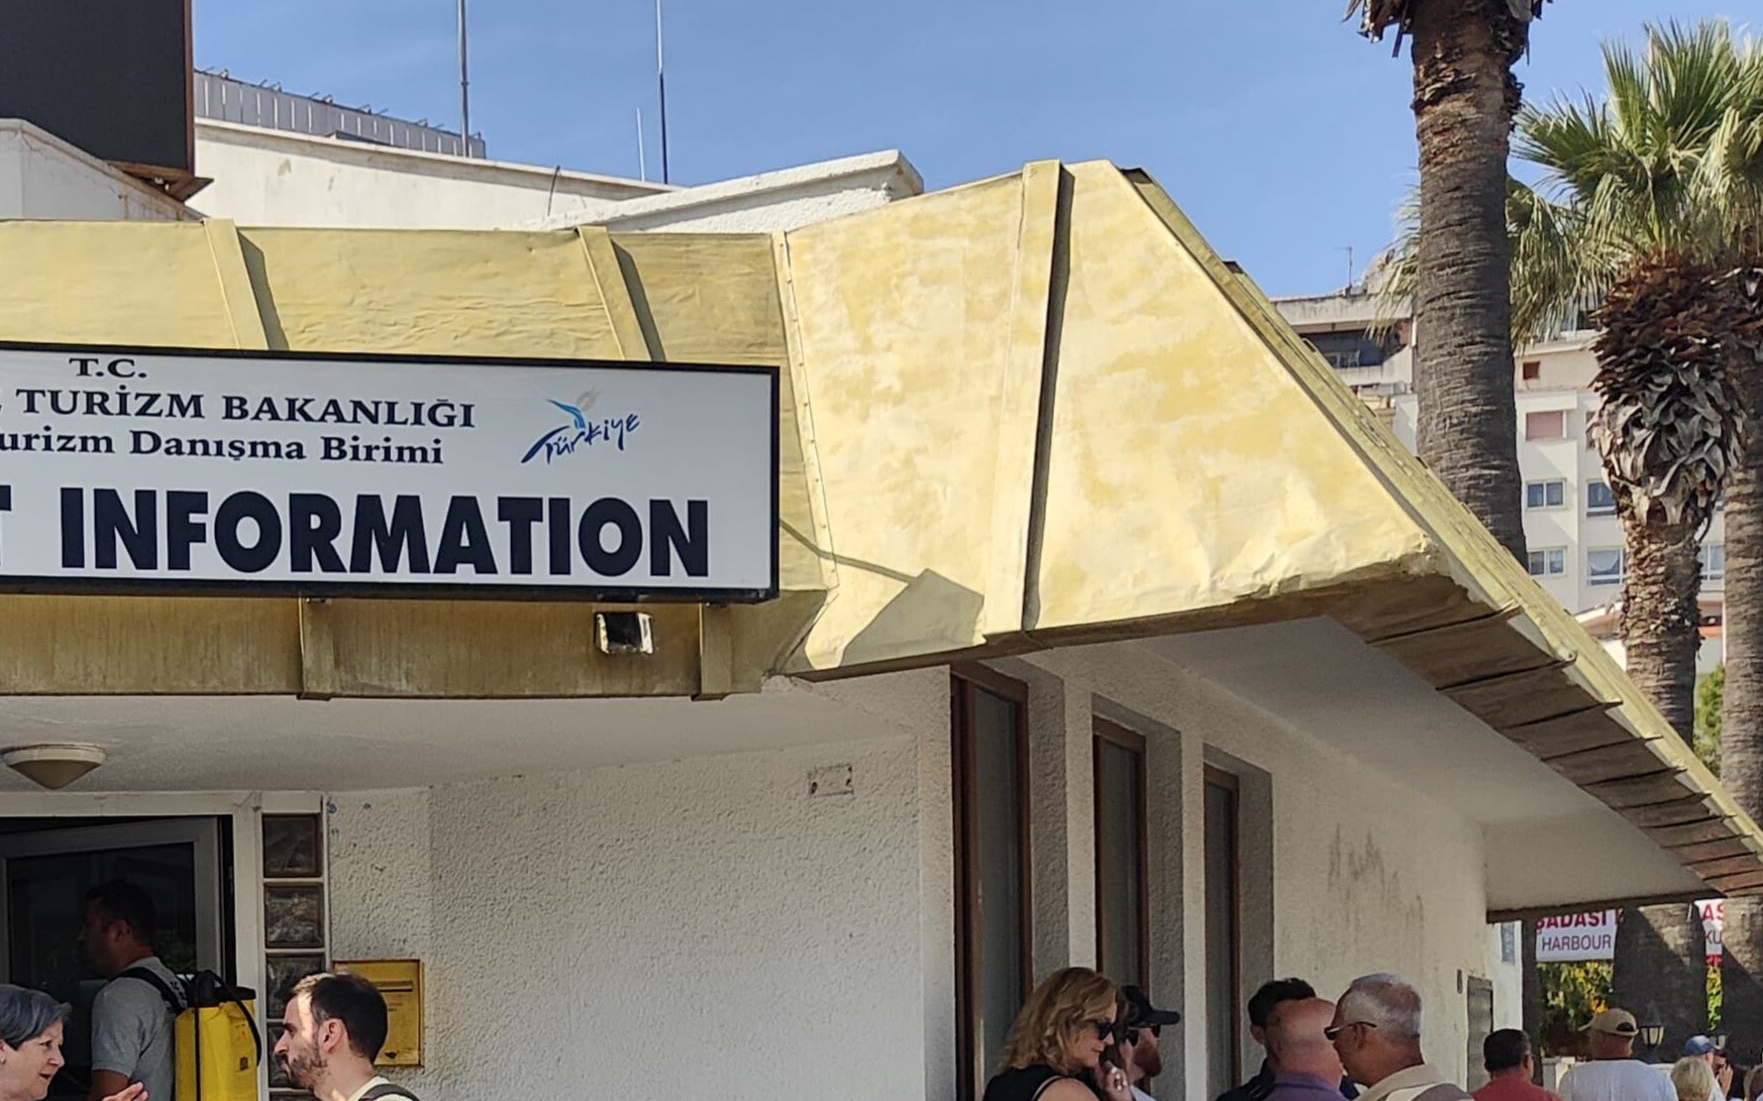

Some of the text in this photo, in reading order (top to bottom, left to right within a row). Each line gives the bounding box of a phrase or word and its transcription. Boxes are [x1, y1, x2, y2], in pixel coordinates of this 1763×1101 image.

[69, 357, 148, 379] T.C.
[15, 384, 206, 419] TURİZM
[221, 395, 476, 429] BAKANLIĞI
[129, 429, 307, 462] Danışma
[319, 434, 444, 465] Birimi
[520, 412, 641, 466] Türkiye
[59, 486, 709, 578] INFORMATION
[1541, 934, 1612, 952] HARBOUR
